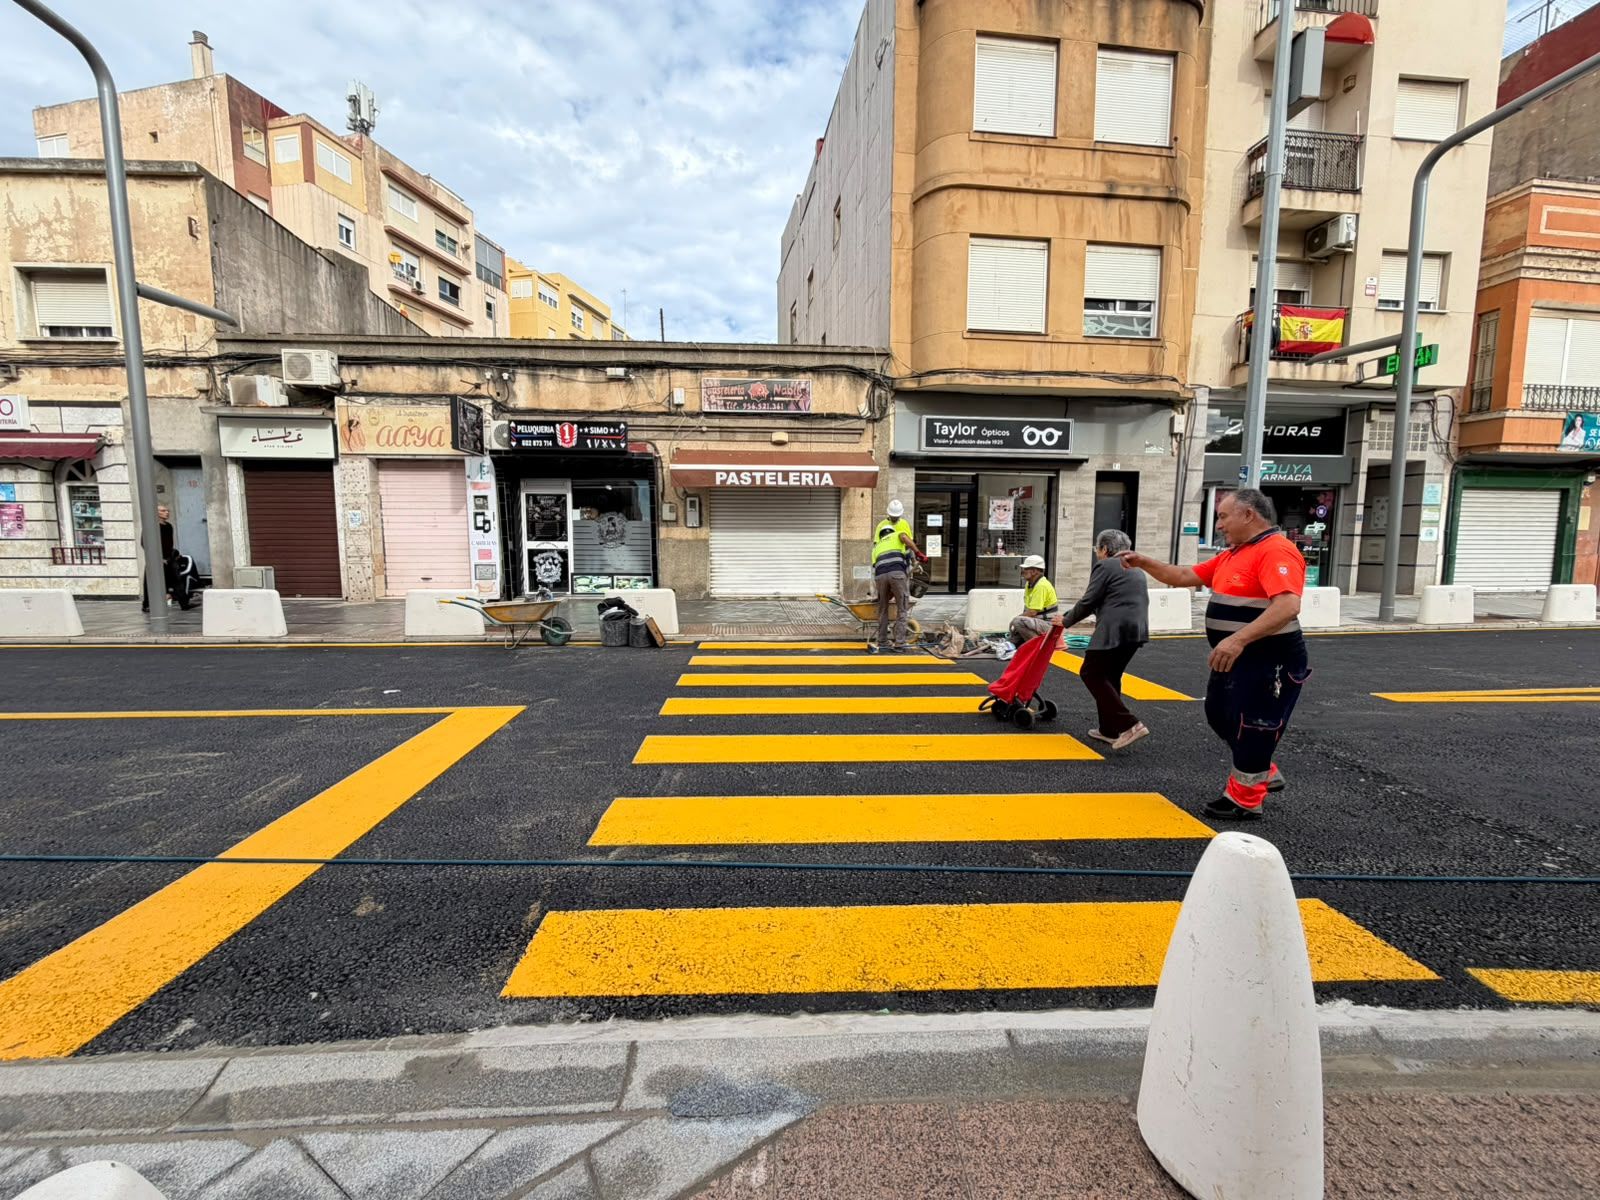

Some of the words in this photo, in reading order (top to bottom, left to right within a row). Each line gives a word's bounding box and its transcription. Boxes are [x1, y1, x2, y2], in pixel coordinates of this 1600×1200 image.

[517, 424, 554, 435] PELUQUERIA
[933, 422, 977, 438] Taylor
[980, 427, 1010, 437] Ópticos
[714, 471, 834, 486] PASTELERIA
